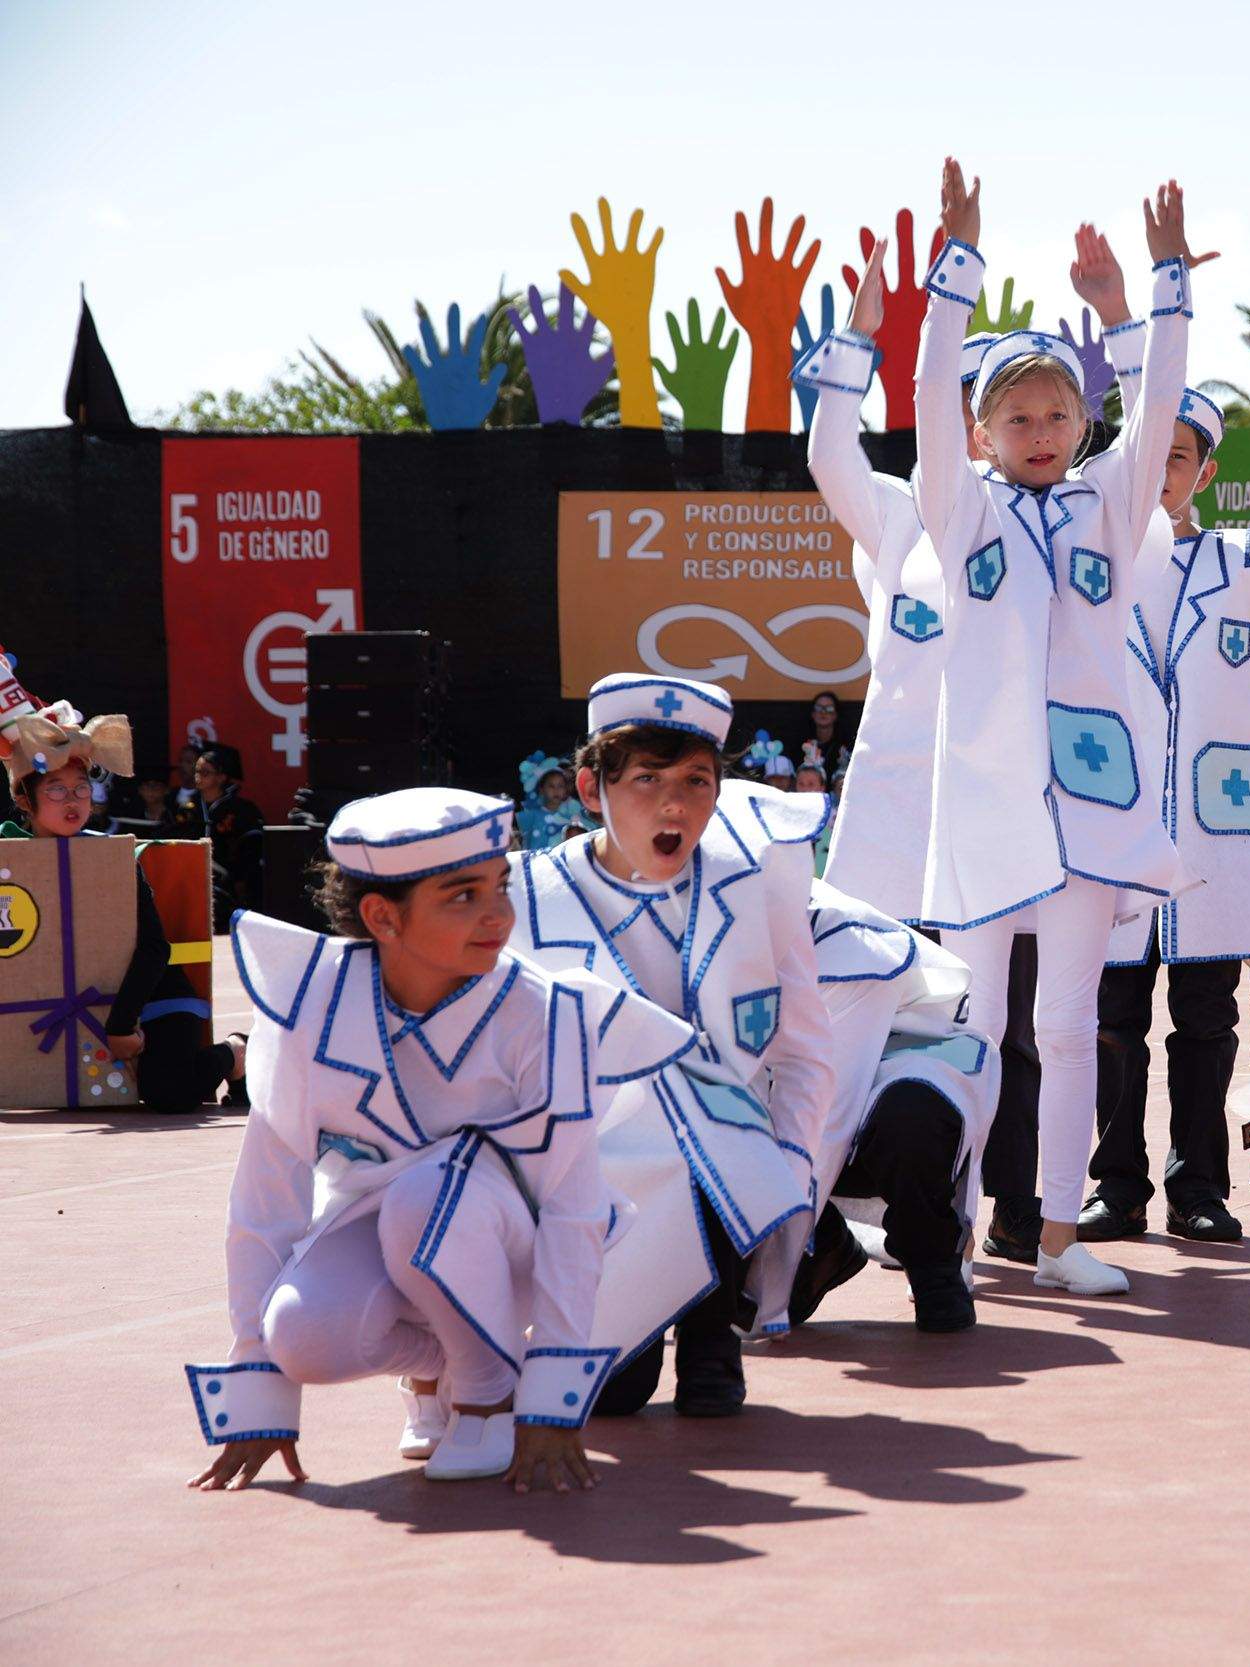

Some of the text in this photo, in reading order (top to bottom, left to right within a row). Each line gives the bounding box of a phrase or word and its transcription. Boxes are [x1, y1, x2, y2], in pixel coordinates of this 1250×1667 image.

[216, 490, 321, 522] IGUALDAD
[170, 493, 199, 563] 5
[587, 508, 666, 560] 12
[684, 531, 833, 552] Y CONSUMO
[218, 531, 244, 561] DE
[683, 558, 855, 580] RESPONSABL
